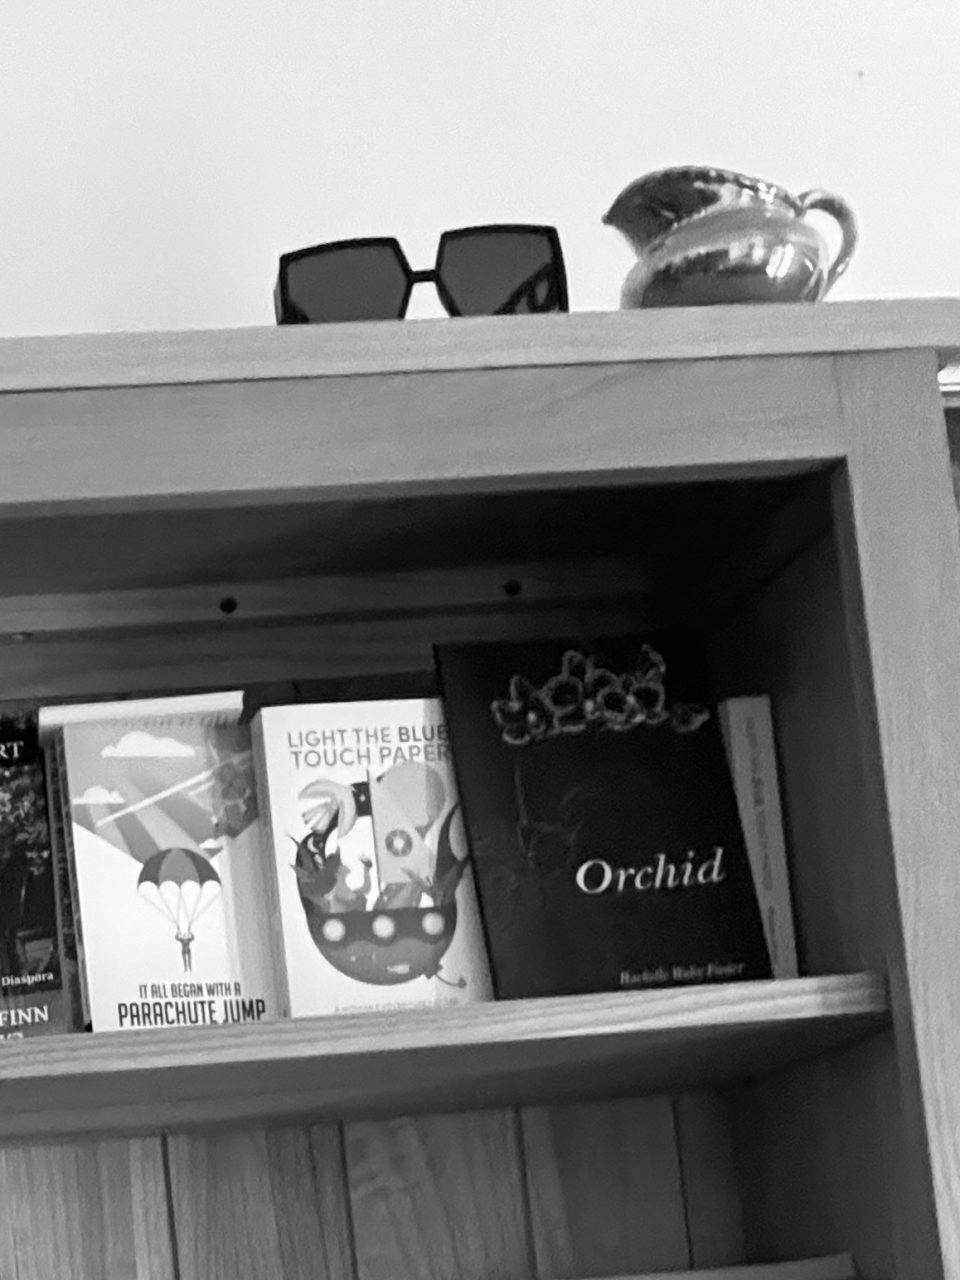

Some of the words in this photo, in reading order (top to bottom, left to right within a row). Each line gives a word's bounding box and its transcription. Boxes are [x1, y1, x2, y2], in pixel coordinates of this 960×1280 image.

[287, 729, 347, 748] LIGHT
[352, 727, 391, 744] THE
[398, 724, 449, 744] BLUE
[290, 747, 370, 769] TOUCH
[380, 744, 452, 765] PAPER
[575, 846, 726, 893] Orchid
[1, 971, 54, 988] Diaspora
[139, 984, 148, 999] IT
[151, 984, 169, 998] ALL
[171, 983, 204, 998] BEGAN
[206, 982, 231, 997] WITH
[234, 982, 242, 996] A
[117, 1000, 218, 1027] PARACHUTE
[222, 999, 266, 1025] JUMP
